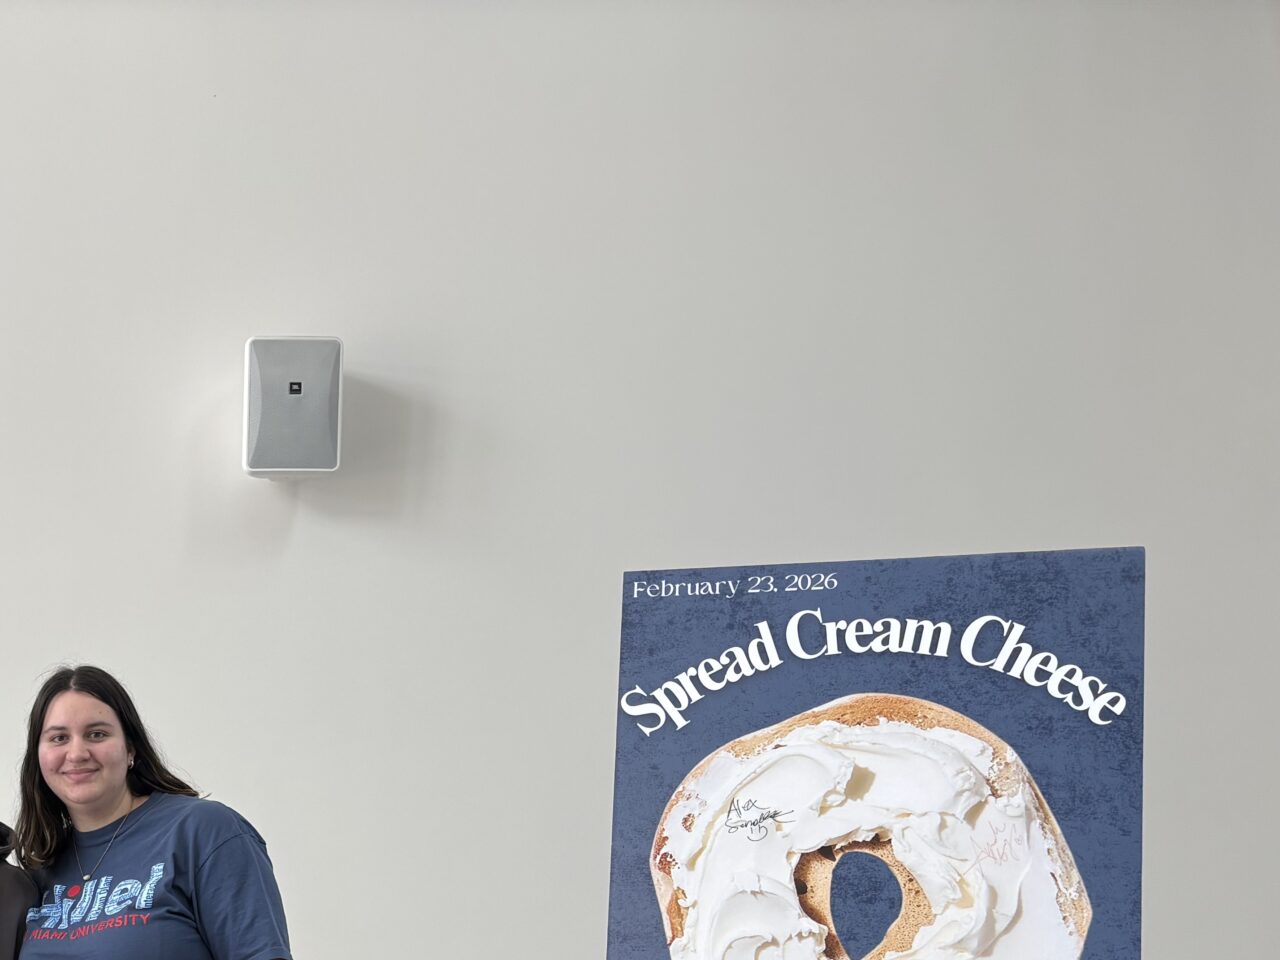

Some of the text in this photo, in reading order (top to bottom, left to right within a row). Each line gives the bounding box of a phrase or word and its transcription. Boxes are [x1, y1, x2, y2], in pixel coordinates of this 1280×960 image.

[632, 579, 740, 598] February
[785, 572, 838, 591] 2026
[620, 608, 1127, 737] Spread Cream Cheese
[26, 862, 164, 929] Hillel
[70, 912, 151, 940] UNIVERSITY
